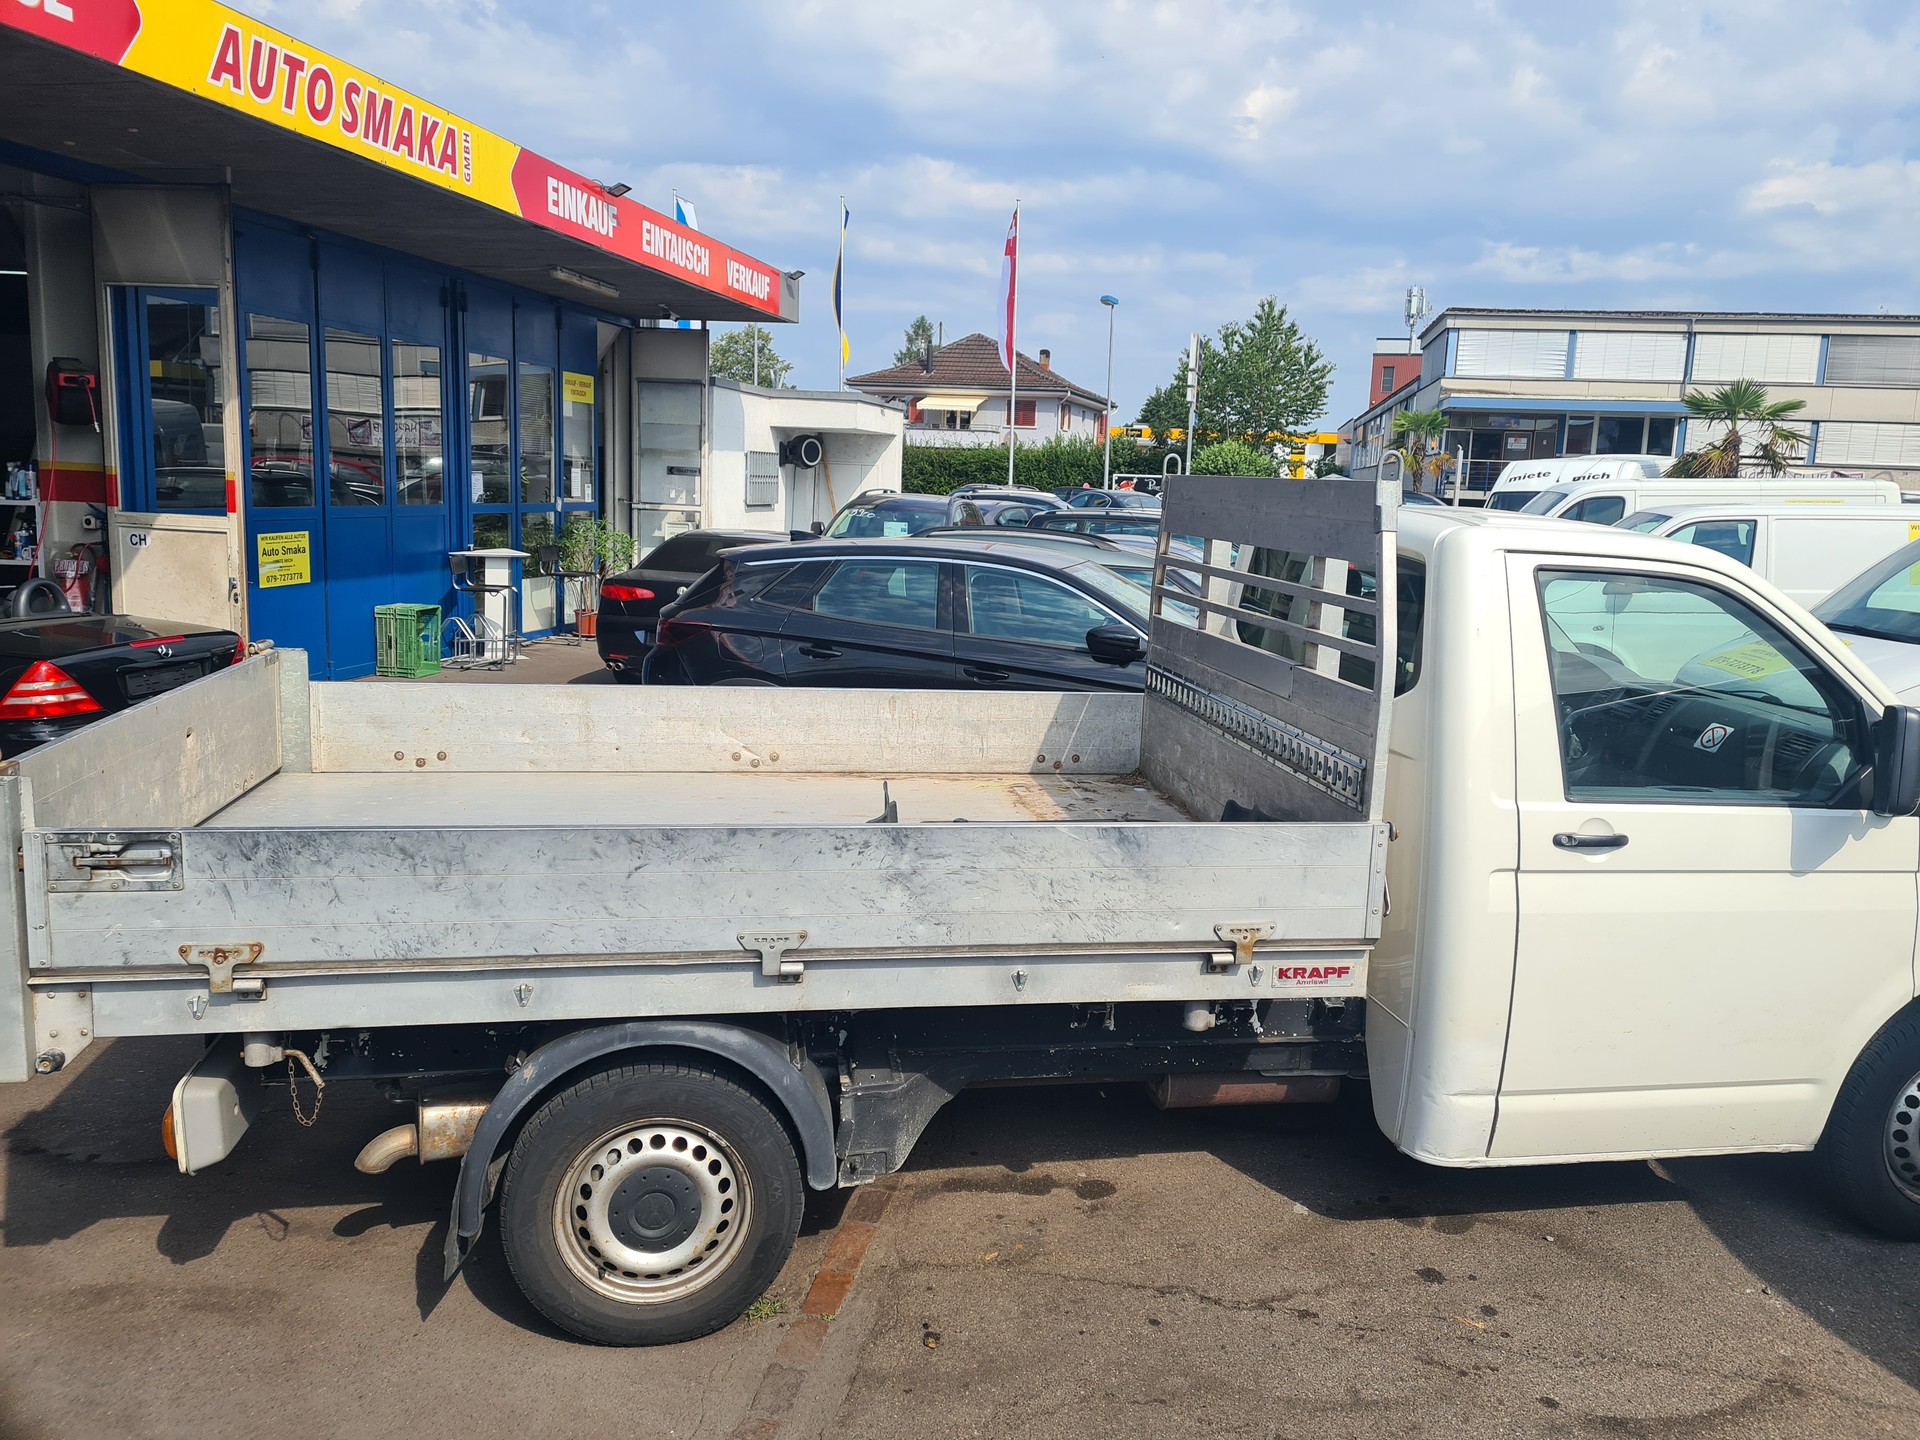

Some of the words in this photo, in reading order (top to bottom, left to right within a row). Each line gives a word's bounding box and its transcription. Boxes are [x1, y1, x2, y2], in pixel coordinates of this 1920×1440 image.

[207, 23, 335, 126] AUTO
[340, 79, 458, 178] SMAKA
[463, 131, 471, 183] GMBH
[547, 176, 617, 238] EINKAUF
[642, 220, 710, 277] EINTAUSCH
[727, 258, 771, 301] VERKAUF
[1508, 471, 1551, 482] miete
[1572, 472, 1610, 481] mich
[130, 534, 147, 546] CH
[262, 547, 279, 557] Auto
[281, 544, 306, 555] Smaka
[266, 572, 303, 583] 079-7273778
[1278, 966, 1351, 980] KRAPF
[1295, 978, 1329, 986] Amriswil
